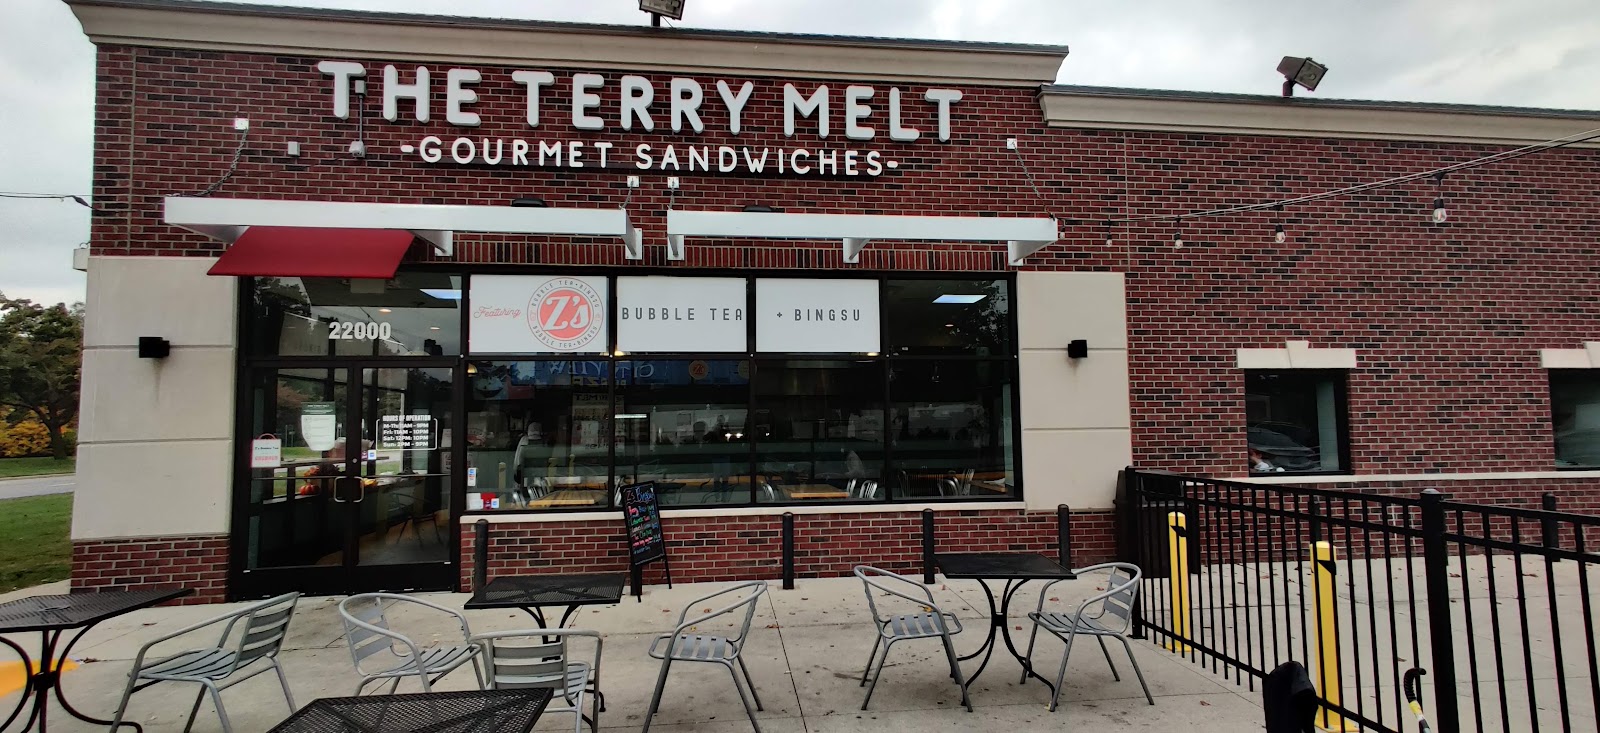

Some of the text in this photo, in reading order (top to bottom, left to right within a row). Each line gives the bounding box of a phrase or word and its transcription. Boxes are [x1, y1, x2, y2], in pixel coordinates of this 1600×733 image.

[317, 60, 964, 143] THE TERRY MELT
[473, 305, 521, 319] Featuring
[542, 295, 590, 331] Z's
[622, 307, 743, 321] BUBBLE TEA
[794, 308, 861, 321] BINGSU
[328, 321, 392, 340] 22000
